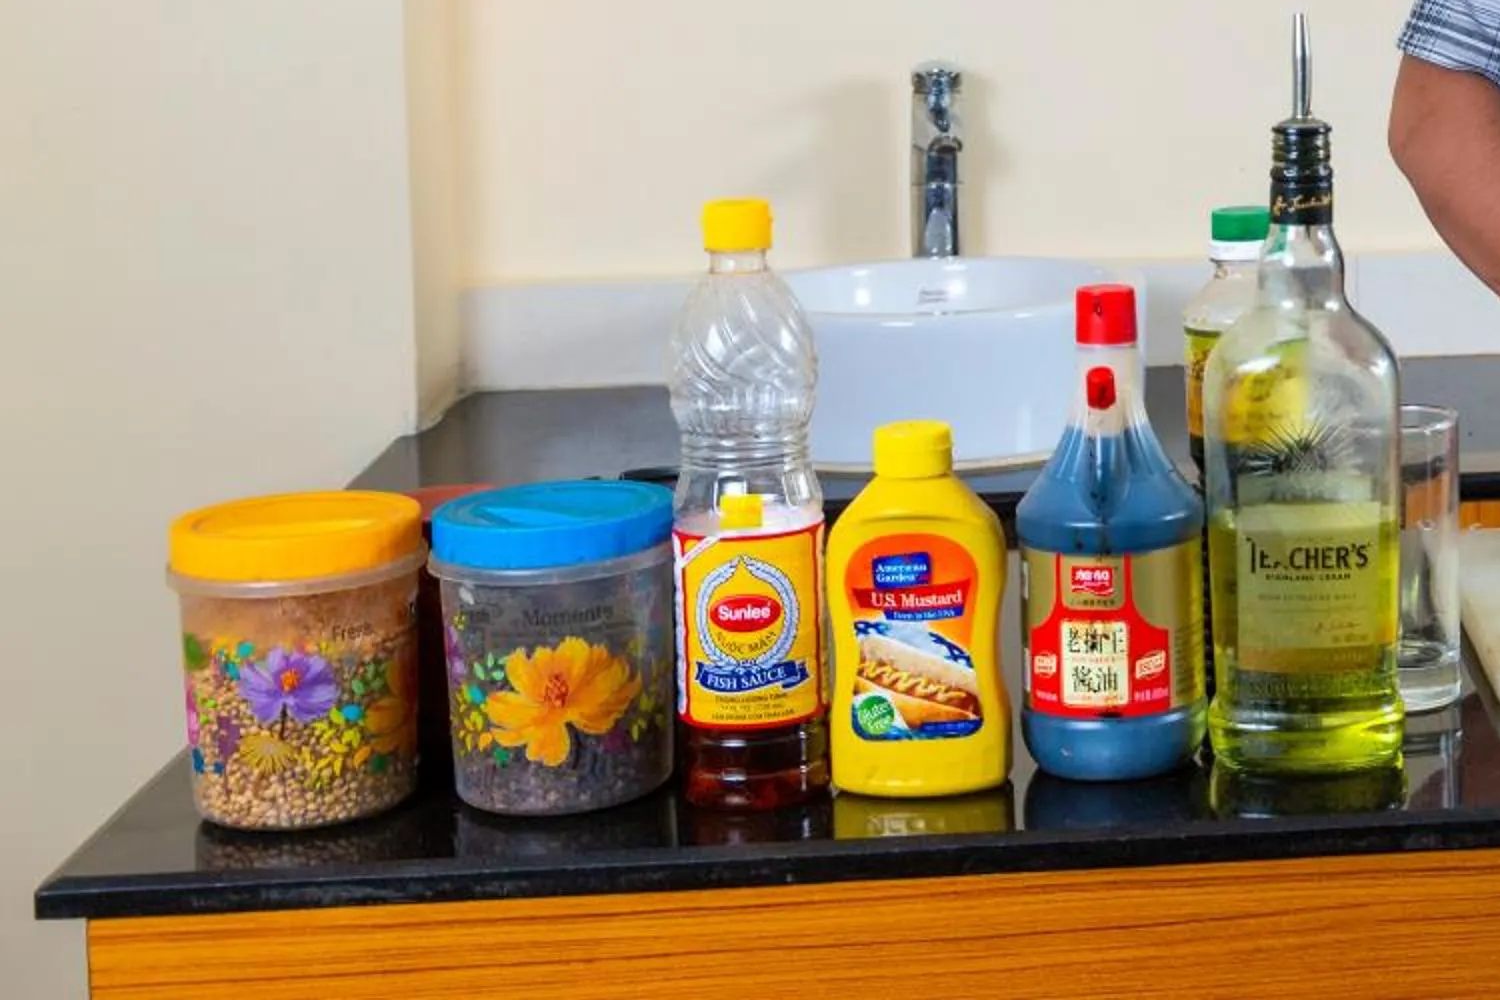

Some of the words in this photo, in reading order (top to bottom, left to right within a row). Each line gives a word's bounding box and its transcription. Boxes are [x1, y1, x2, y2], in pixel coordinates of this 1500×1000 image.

[876, 563, 927, 573] American
[876, 573, 917, 583] Garden
[900, 589, 963, 608] Mustard
[717, 605, 771, 622] Sunlee
[707, 674, 738, 690] FISH
[740, 666, 787, 688] SAUCE
